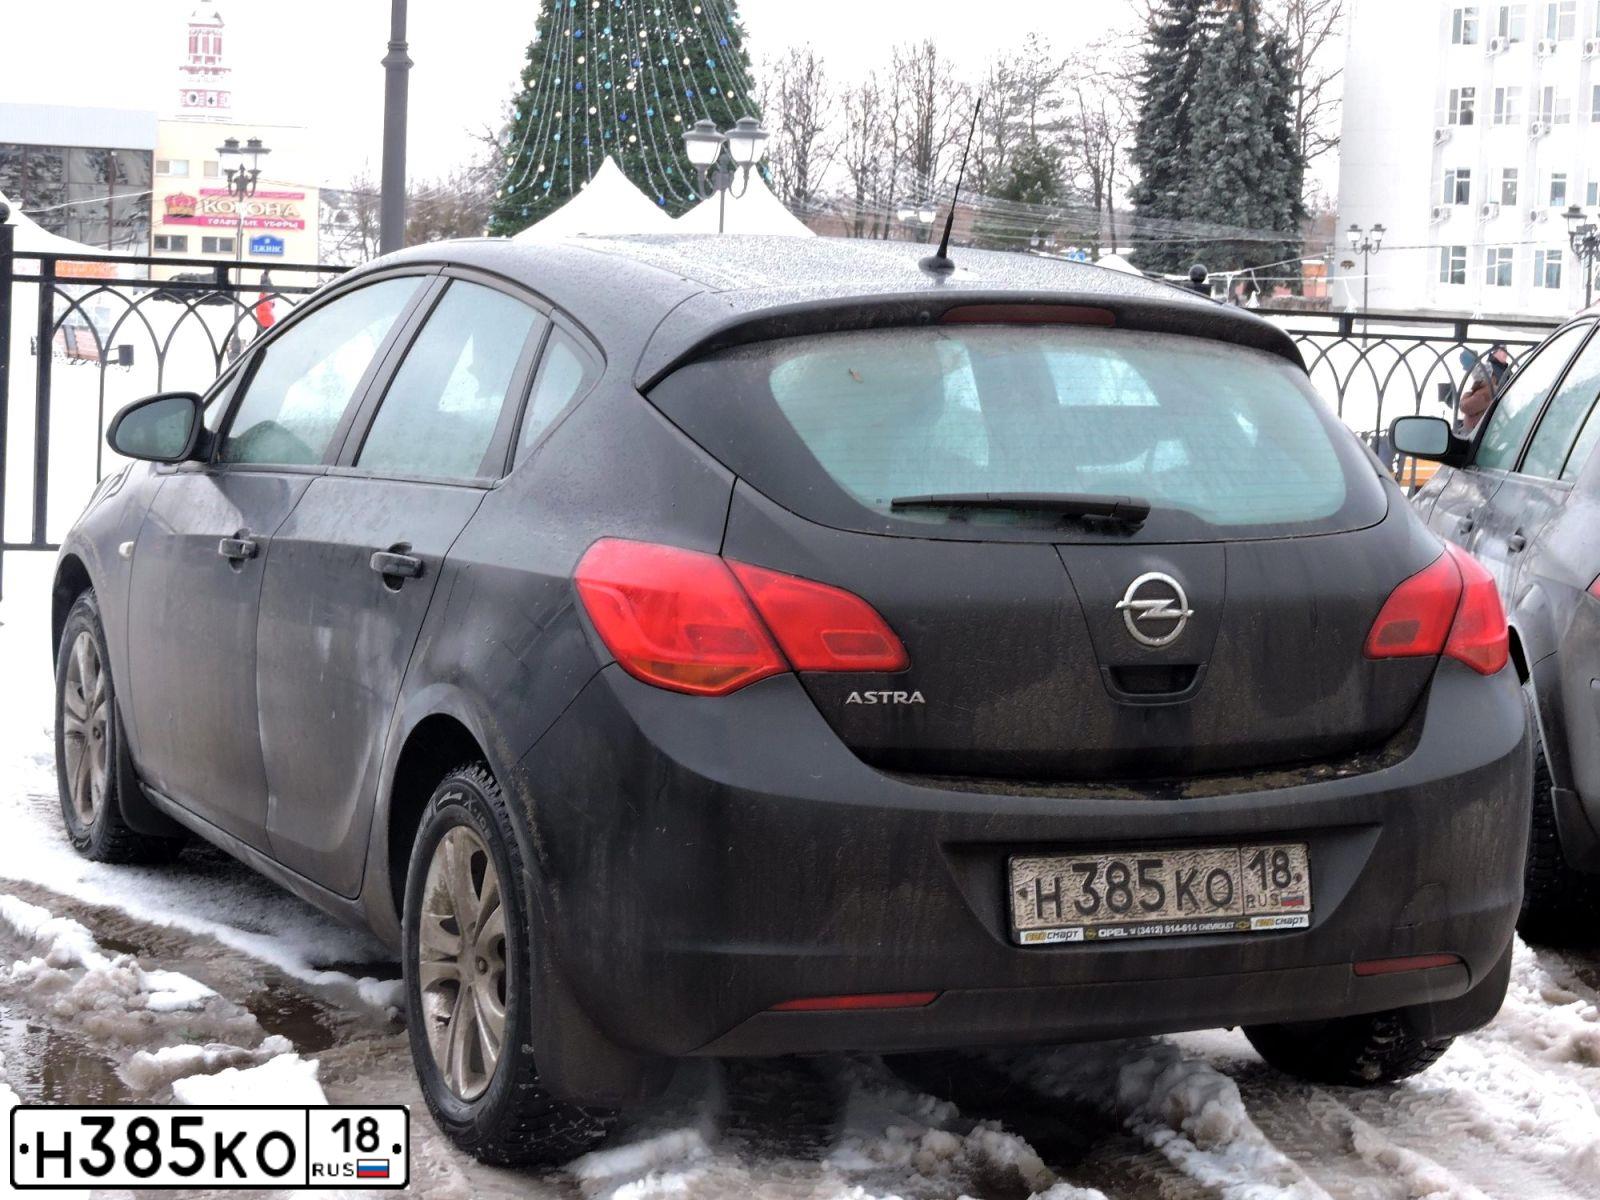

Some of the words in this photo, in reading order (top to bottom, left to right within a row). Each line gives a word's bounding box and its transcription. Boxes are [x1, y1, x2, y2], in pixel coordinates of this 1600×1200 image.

[207, 218, 258, 227] ГОЛОВЫЕ
[845, 691, 926, 704] ASTRA
[1246, 850, 1292, 891] 18
[1246, 893, 1279, 908] RUS
[1098, 928, 1128, 938] OPEL
